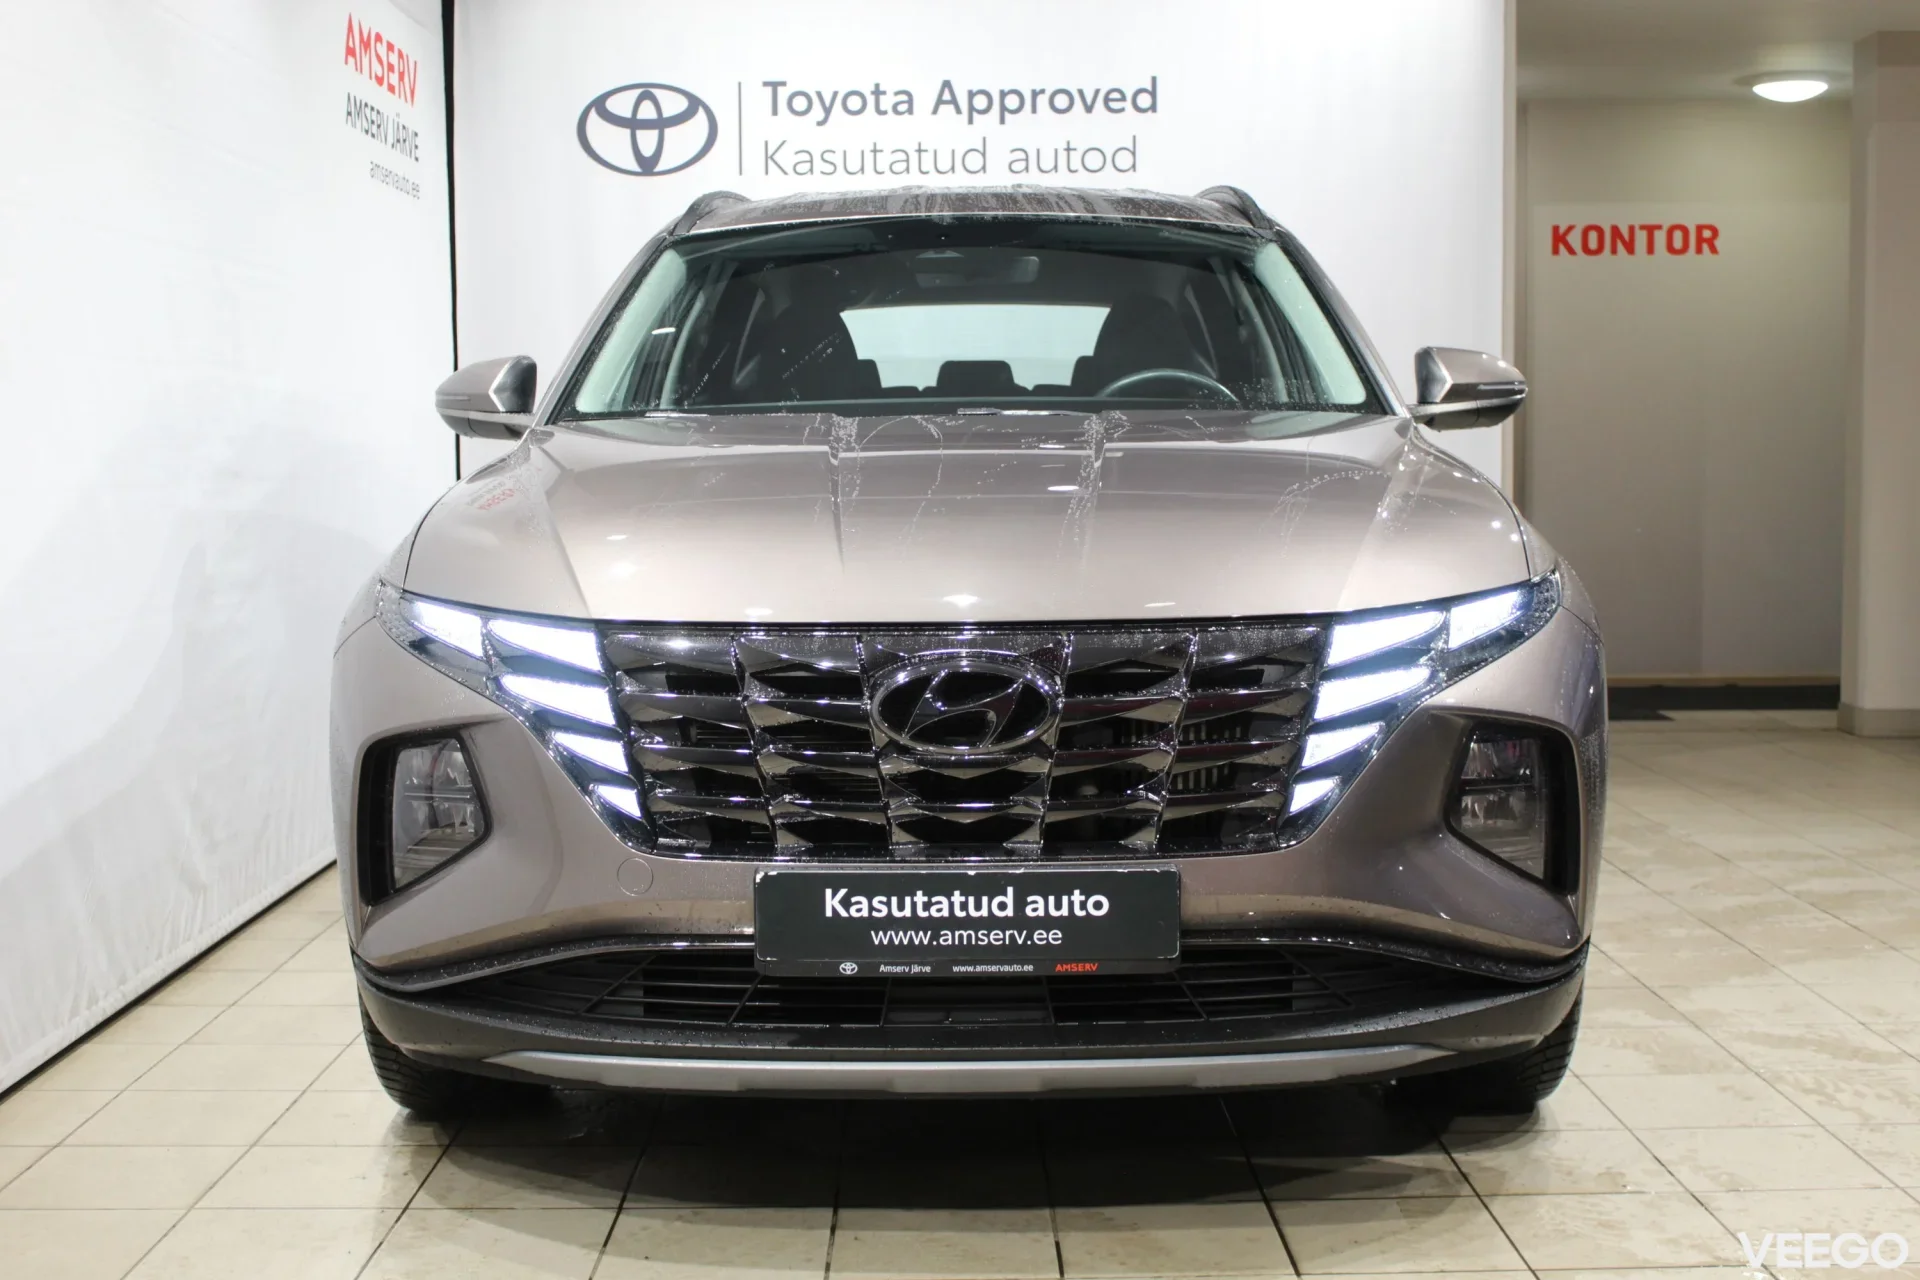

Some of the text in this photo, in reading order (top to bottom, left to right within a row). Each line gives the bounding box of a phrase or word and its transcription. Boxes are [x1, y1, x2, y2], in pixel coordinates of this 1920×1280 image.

[344, 12, 417, 108] AMSERV
[762, 75, 1158, 126] Toyota Approved
[345, 92, 419, 162] AMSERV JÄRVE
[763, 134, 1137, 176] Kasutatud autod
[369, 160, 420, 200] amservauto.ee
[1551, 223, 1720, 256] KONTOR
[824, 886, 1110, 918] Kasutatud auto
[870, 929, 1063, 946] www.amserv.ee
[879, 962, 932, 975] Amserv Järve
[952, 963, 1034, 973] www.amservauto.ee
[1055, 962, 1099, 973] AMSERV
